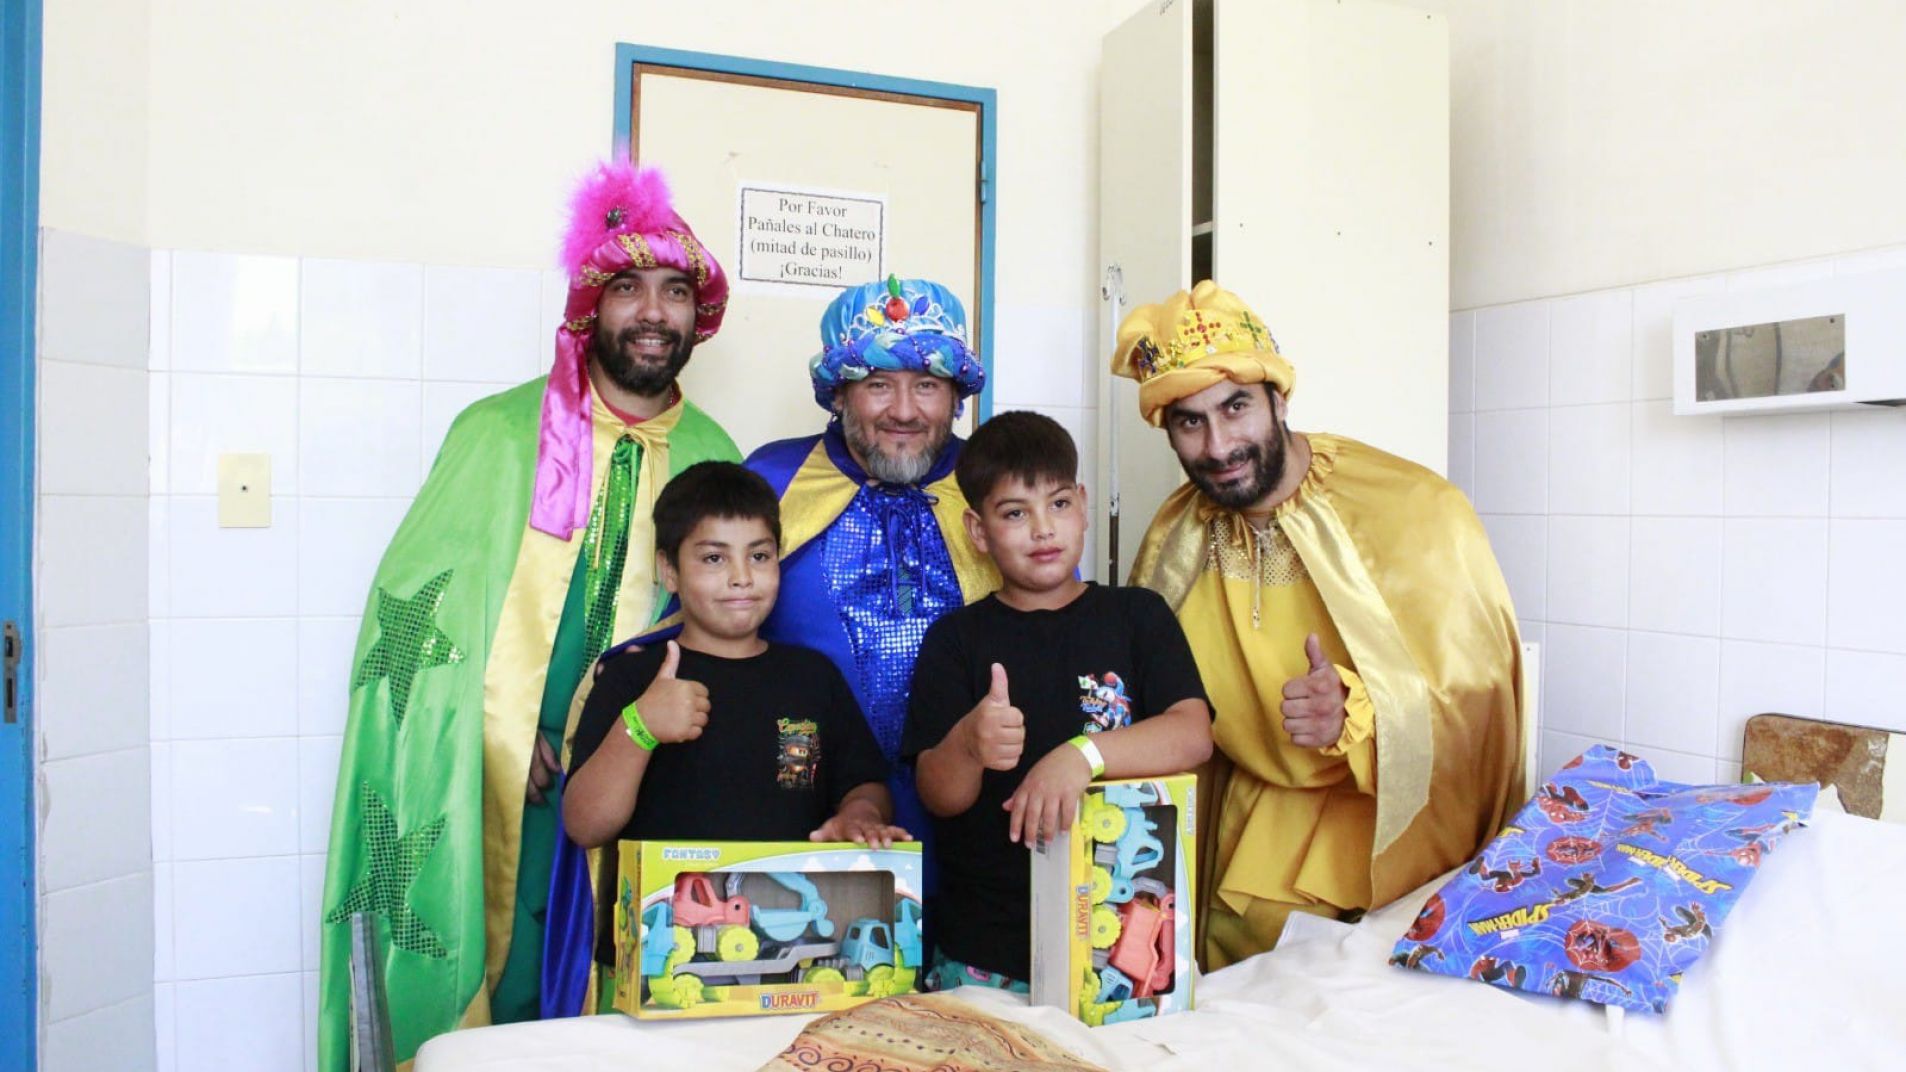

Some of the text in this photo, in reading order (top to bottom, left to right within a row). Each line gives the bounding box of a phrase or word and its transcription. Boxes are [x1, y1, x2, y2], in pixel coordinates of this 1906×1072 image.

[779, 198, 848, 218] Por Favor
[748, 216, 876, 241] Pañales al Chatero
[750, 239, 872, 264] (mitad de pasillo)
[780, 261, 843, 280] ¡Gracias!
[760, 991, 817, 1009] DURAVIT
